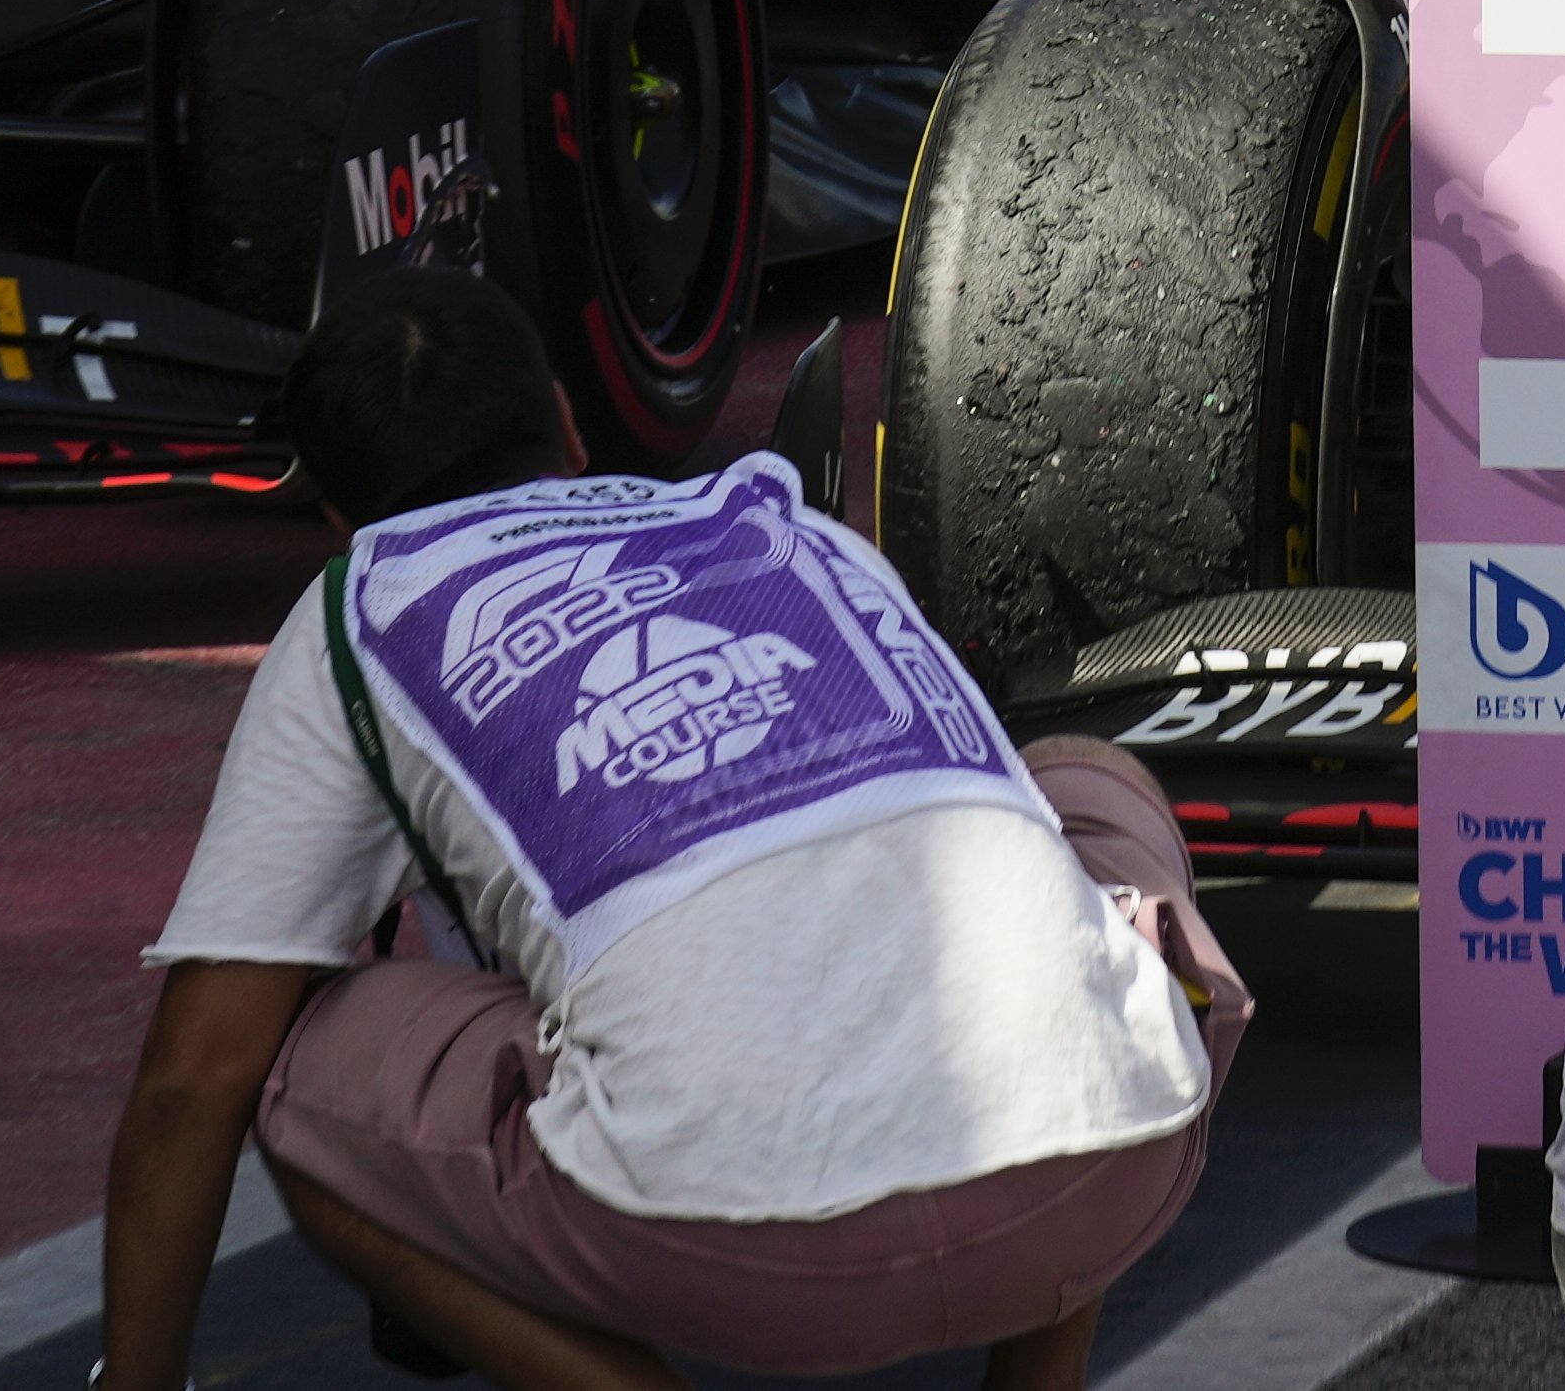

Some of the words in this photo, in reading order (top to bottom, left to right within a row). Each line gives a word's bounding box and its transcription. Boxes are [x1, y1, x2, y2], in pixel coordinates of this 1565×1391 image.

[344, 119, 468, 257] Mobil
[441, 563, 694, 729] 2022
[555, 631, 818, 800] MEDIA
[600, 678, 796, 792] COURSE
[1475, 695, 1548, 721] BEST
[1484, 818, 1546, 842] BWT
[1460, 931, 1532, 964] THE
